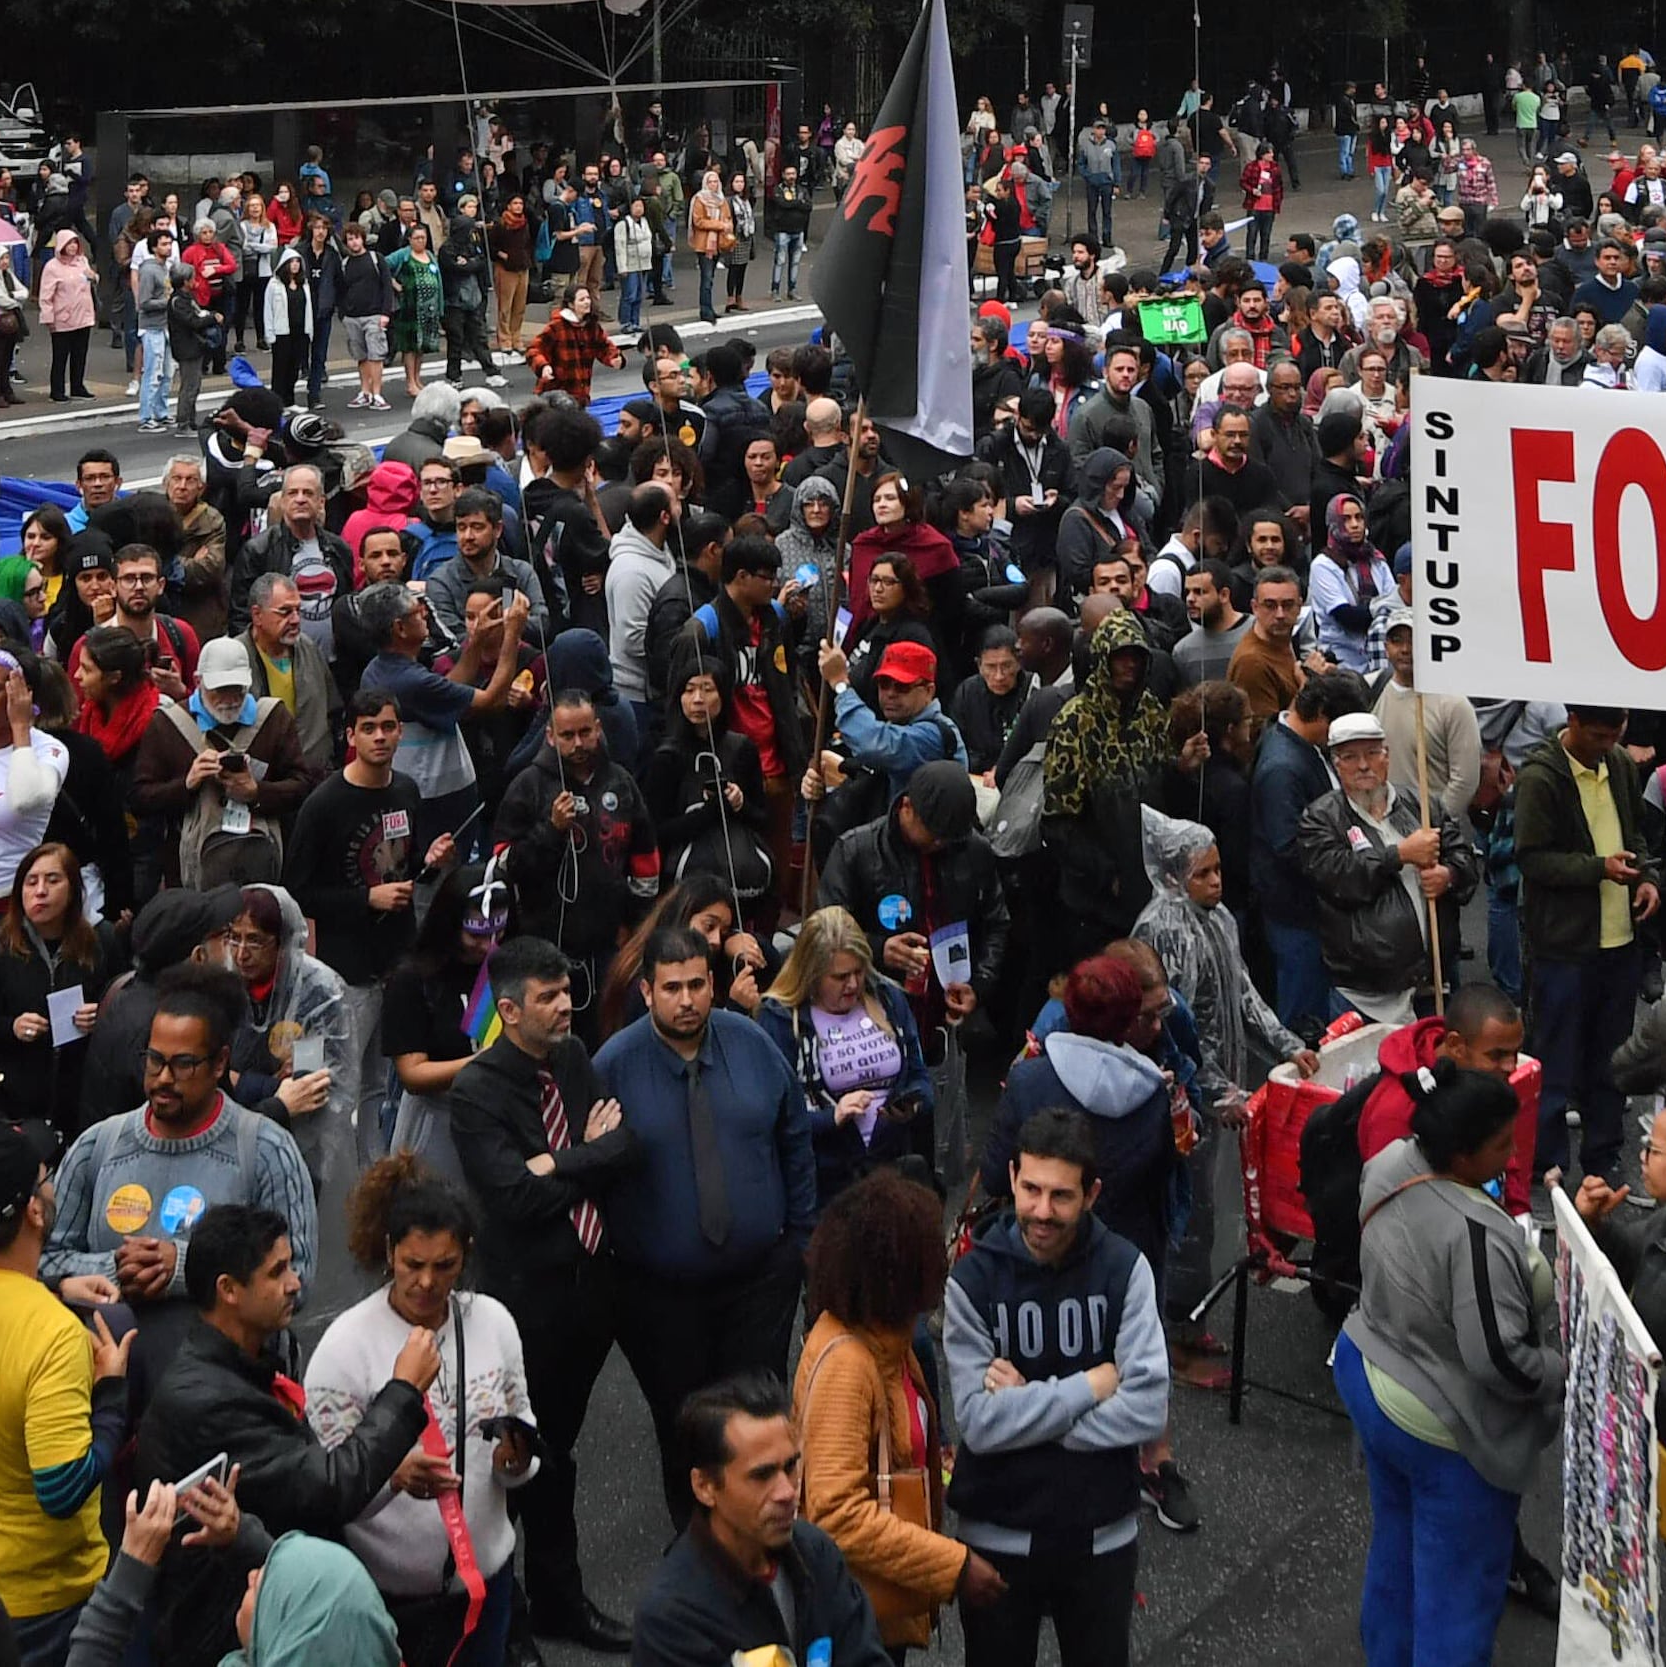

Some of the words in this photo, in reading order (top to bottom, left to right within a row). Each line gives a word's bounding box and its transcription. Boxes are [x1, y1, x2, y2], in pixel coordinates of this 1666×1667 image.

[1424, 411, 1461, 662] SINTUSP
[836, 1044, 856, 1059] SÓ
[859, 1034, 893, 1052] VOTO
[829, 1062, 854, 1077] EM
[856, 1047, 898, 1068] QUEM
[857, 1068, 881, 1081] ME
